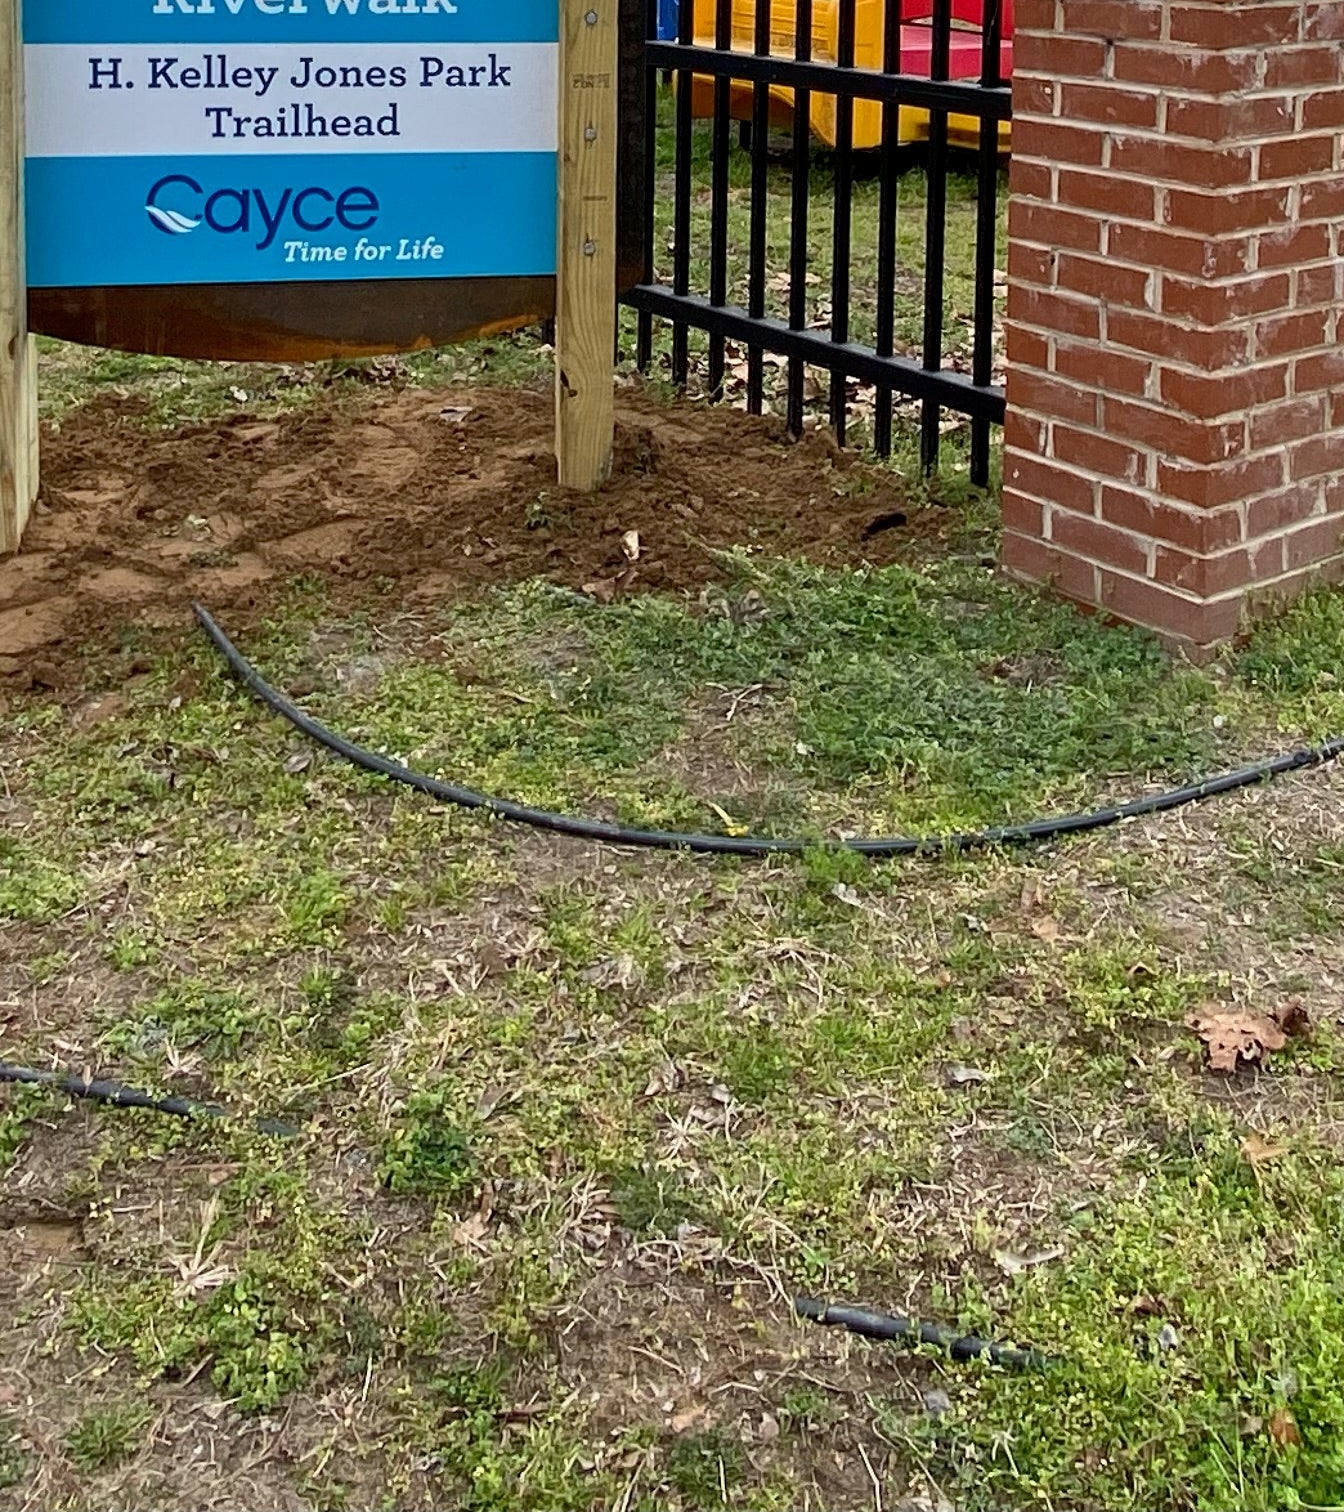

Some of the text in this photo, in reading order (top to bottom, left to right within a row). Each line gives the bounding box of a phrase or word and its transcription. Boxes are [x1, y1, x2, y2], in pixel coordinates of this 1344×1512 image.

[88, 53, 512, 96] H. Kelley Jones Park
[204, 103, 401, 138] Trailhead
[145, 174, 380, 251] Cayce
[283, 236, 445, 263] Time for Life
